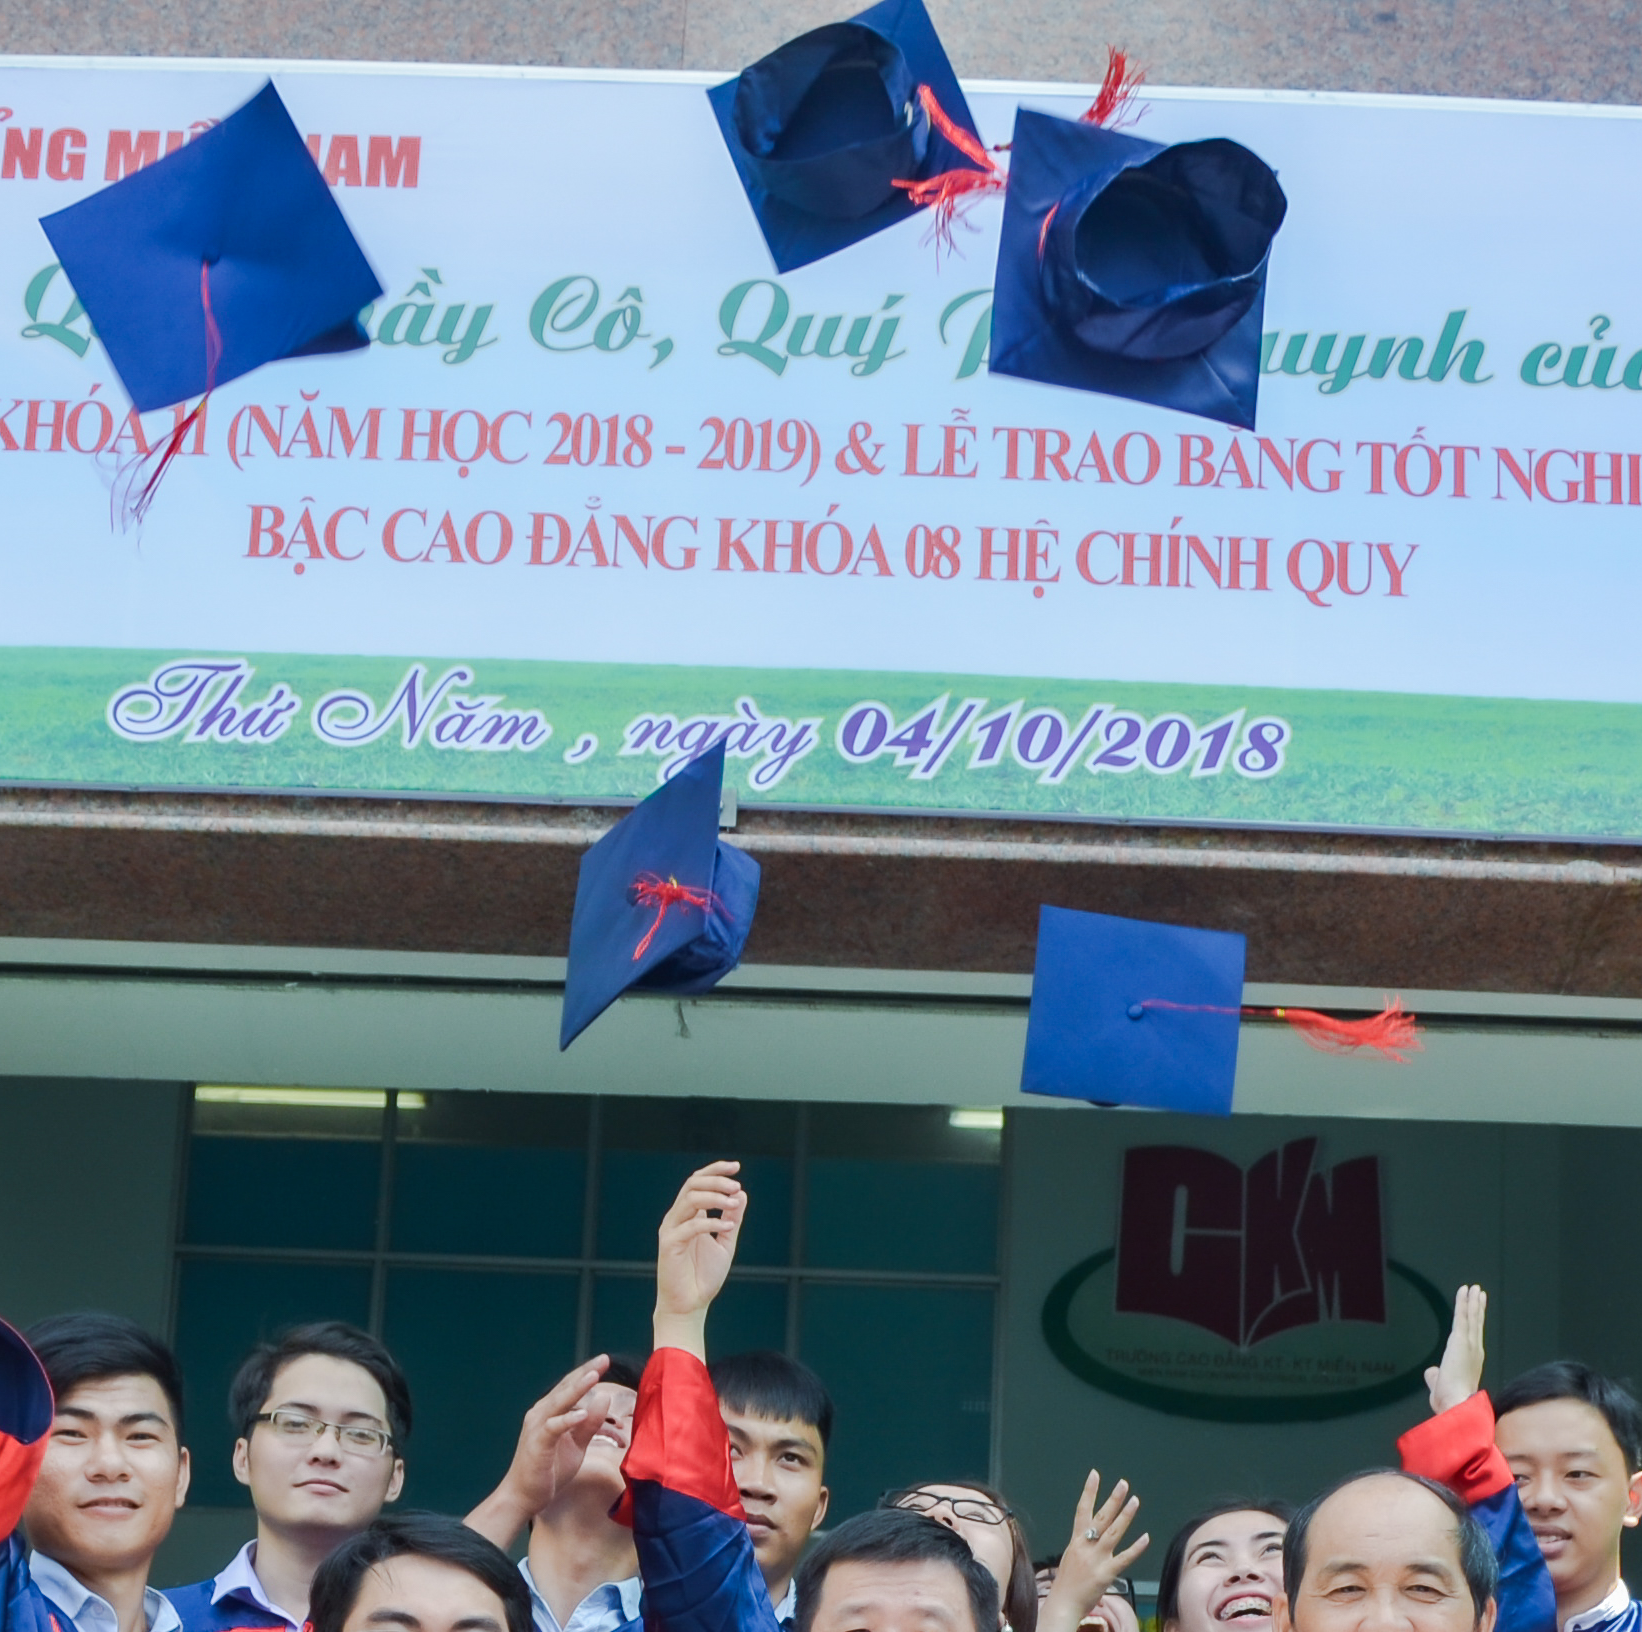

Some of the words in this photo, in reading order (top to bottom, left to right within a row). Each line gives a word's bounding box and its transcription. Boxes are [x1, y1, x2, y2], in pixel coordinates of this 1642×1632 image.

[527, 275, 675, 369] Cô,
[716, 278, 907, 378] Quý
[227, 389, 387, 472] (NĂM
[398, 403, 533, 479] HỌC
[543, 411, 653, 468] 2018
[697, 415, 821, 487] 2019)
[834, 420, 886, 477] &
[899, 408, 978, 479] LỄ
[992, 426, 1162, 486] TRAO
[1357, 426, 1481, 499] TỐT
[244, 496, 370, 576] BẬC
[381, 507, 513, 567] CAO
[524, 496, 701, 573] ĐẲNG
[713, 503, 894, 579] KHÓA
[905, 523, 962, 581] 08
[974, 518, 1061, 599] HỆ
[1075, 516, 1274, 593] CHÍNH
[1286, 537, 1421, 608] QUY
[112, 660, 298, 740] Thứ
[315, 666, 547, 748] Năm
[627, 698, 815, 786] ngày
[839, 699, 1285, 780] 04/10/2018
